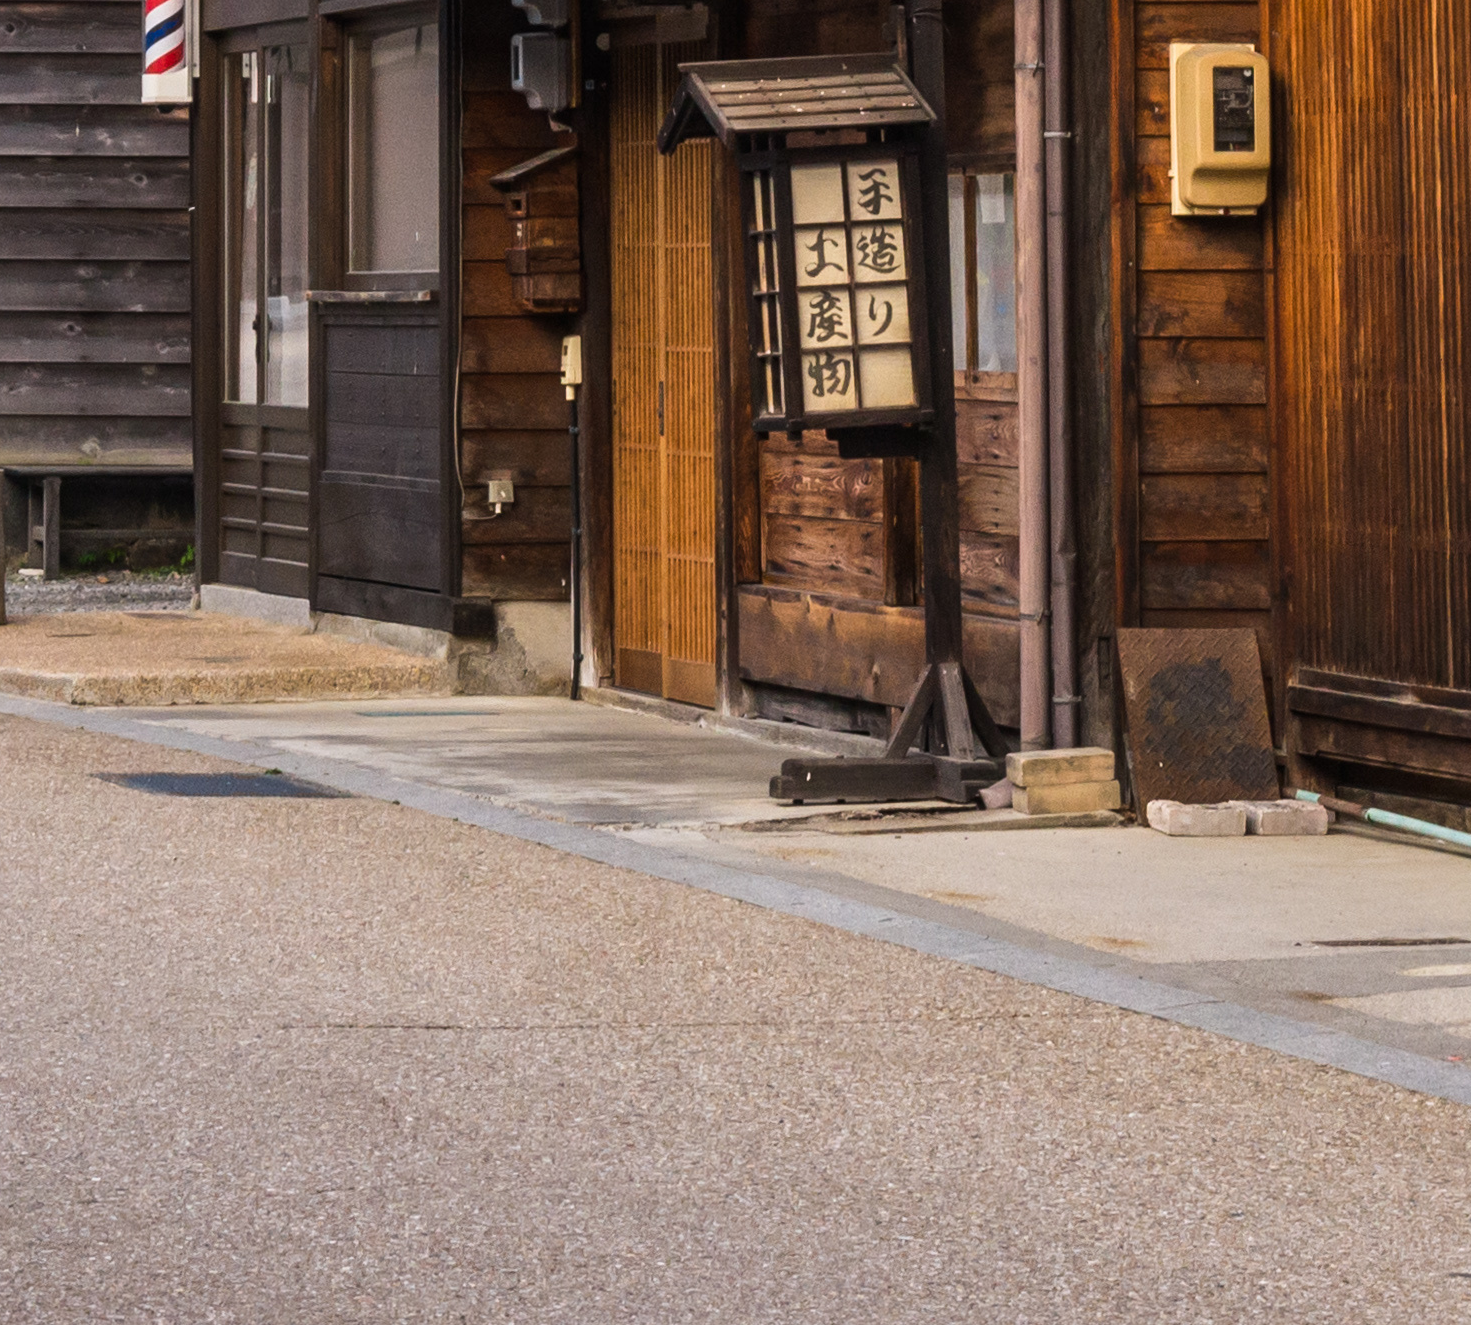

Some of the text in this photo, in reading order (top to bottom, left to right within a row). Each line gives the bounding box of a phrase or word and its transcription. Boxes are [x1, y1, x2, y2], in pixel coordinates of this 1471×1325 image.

[805, 230, 853, 397] 土産物
[856, 168, 901, 336] 手造り
